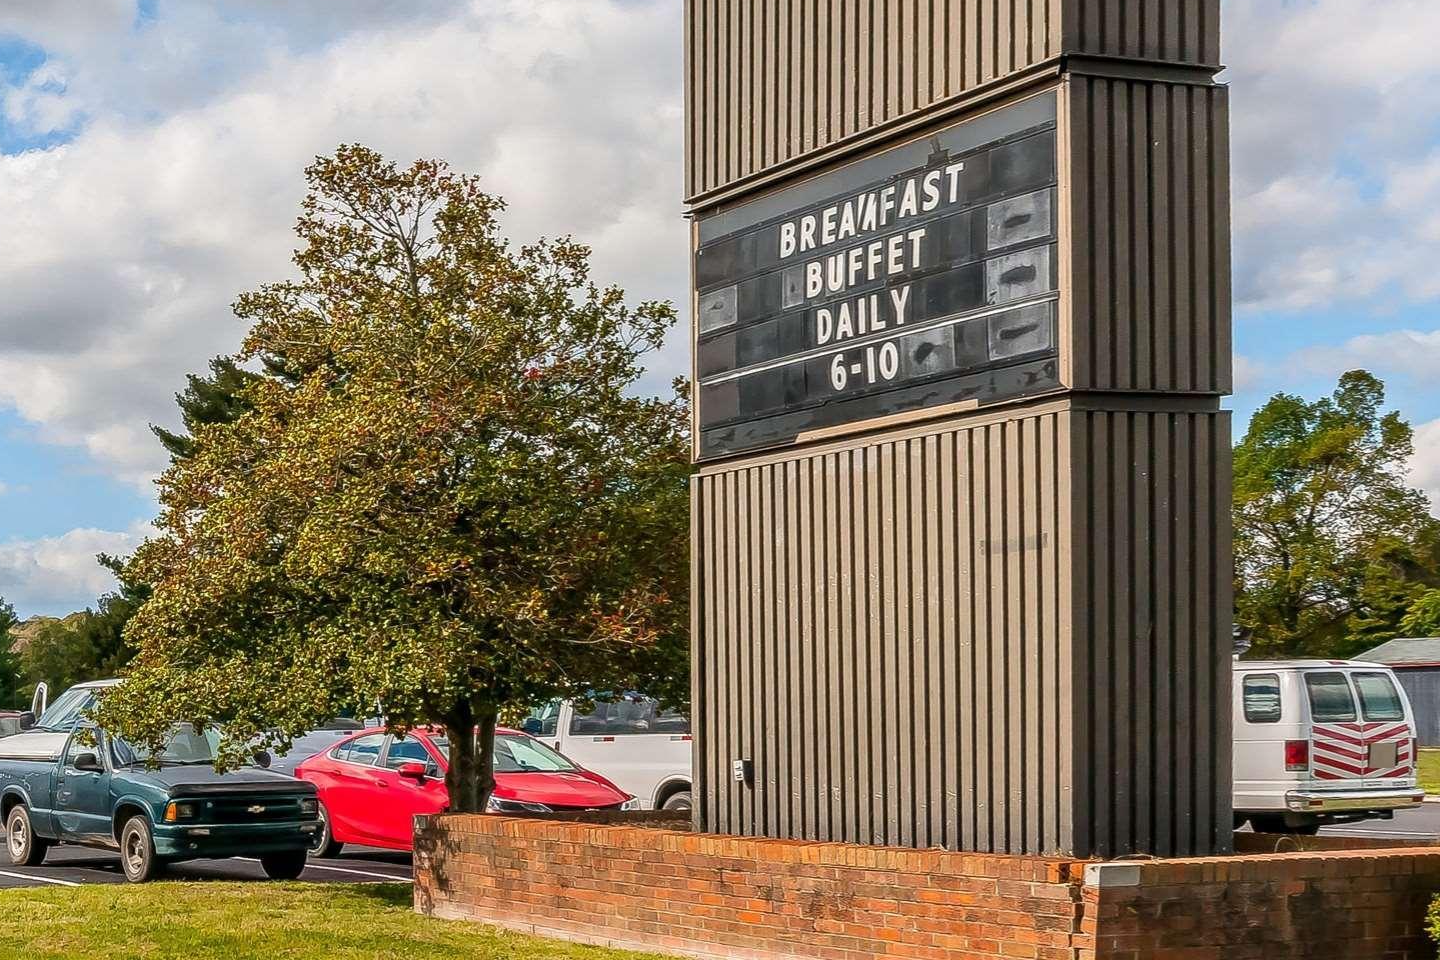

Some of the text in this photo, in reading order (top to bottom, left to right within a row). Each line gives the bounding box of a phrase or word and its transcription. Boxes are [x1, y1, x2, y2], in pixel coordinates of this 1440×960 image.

[806, 228, 926, 299] BUFFET
[816, 285, 910, 345] DAILY
[830, 341, 899, 391] 6-10
